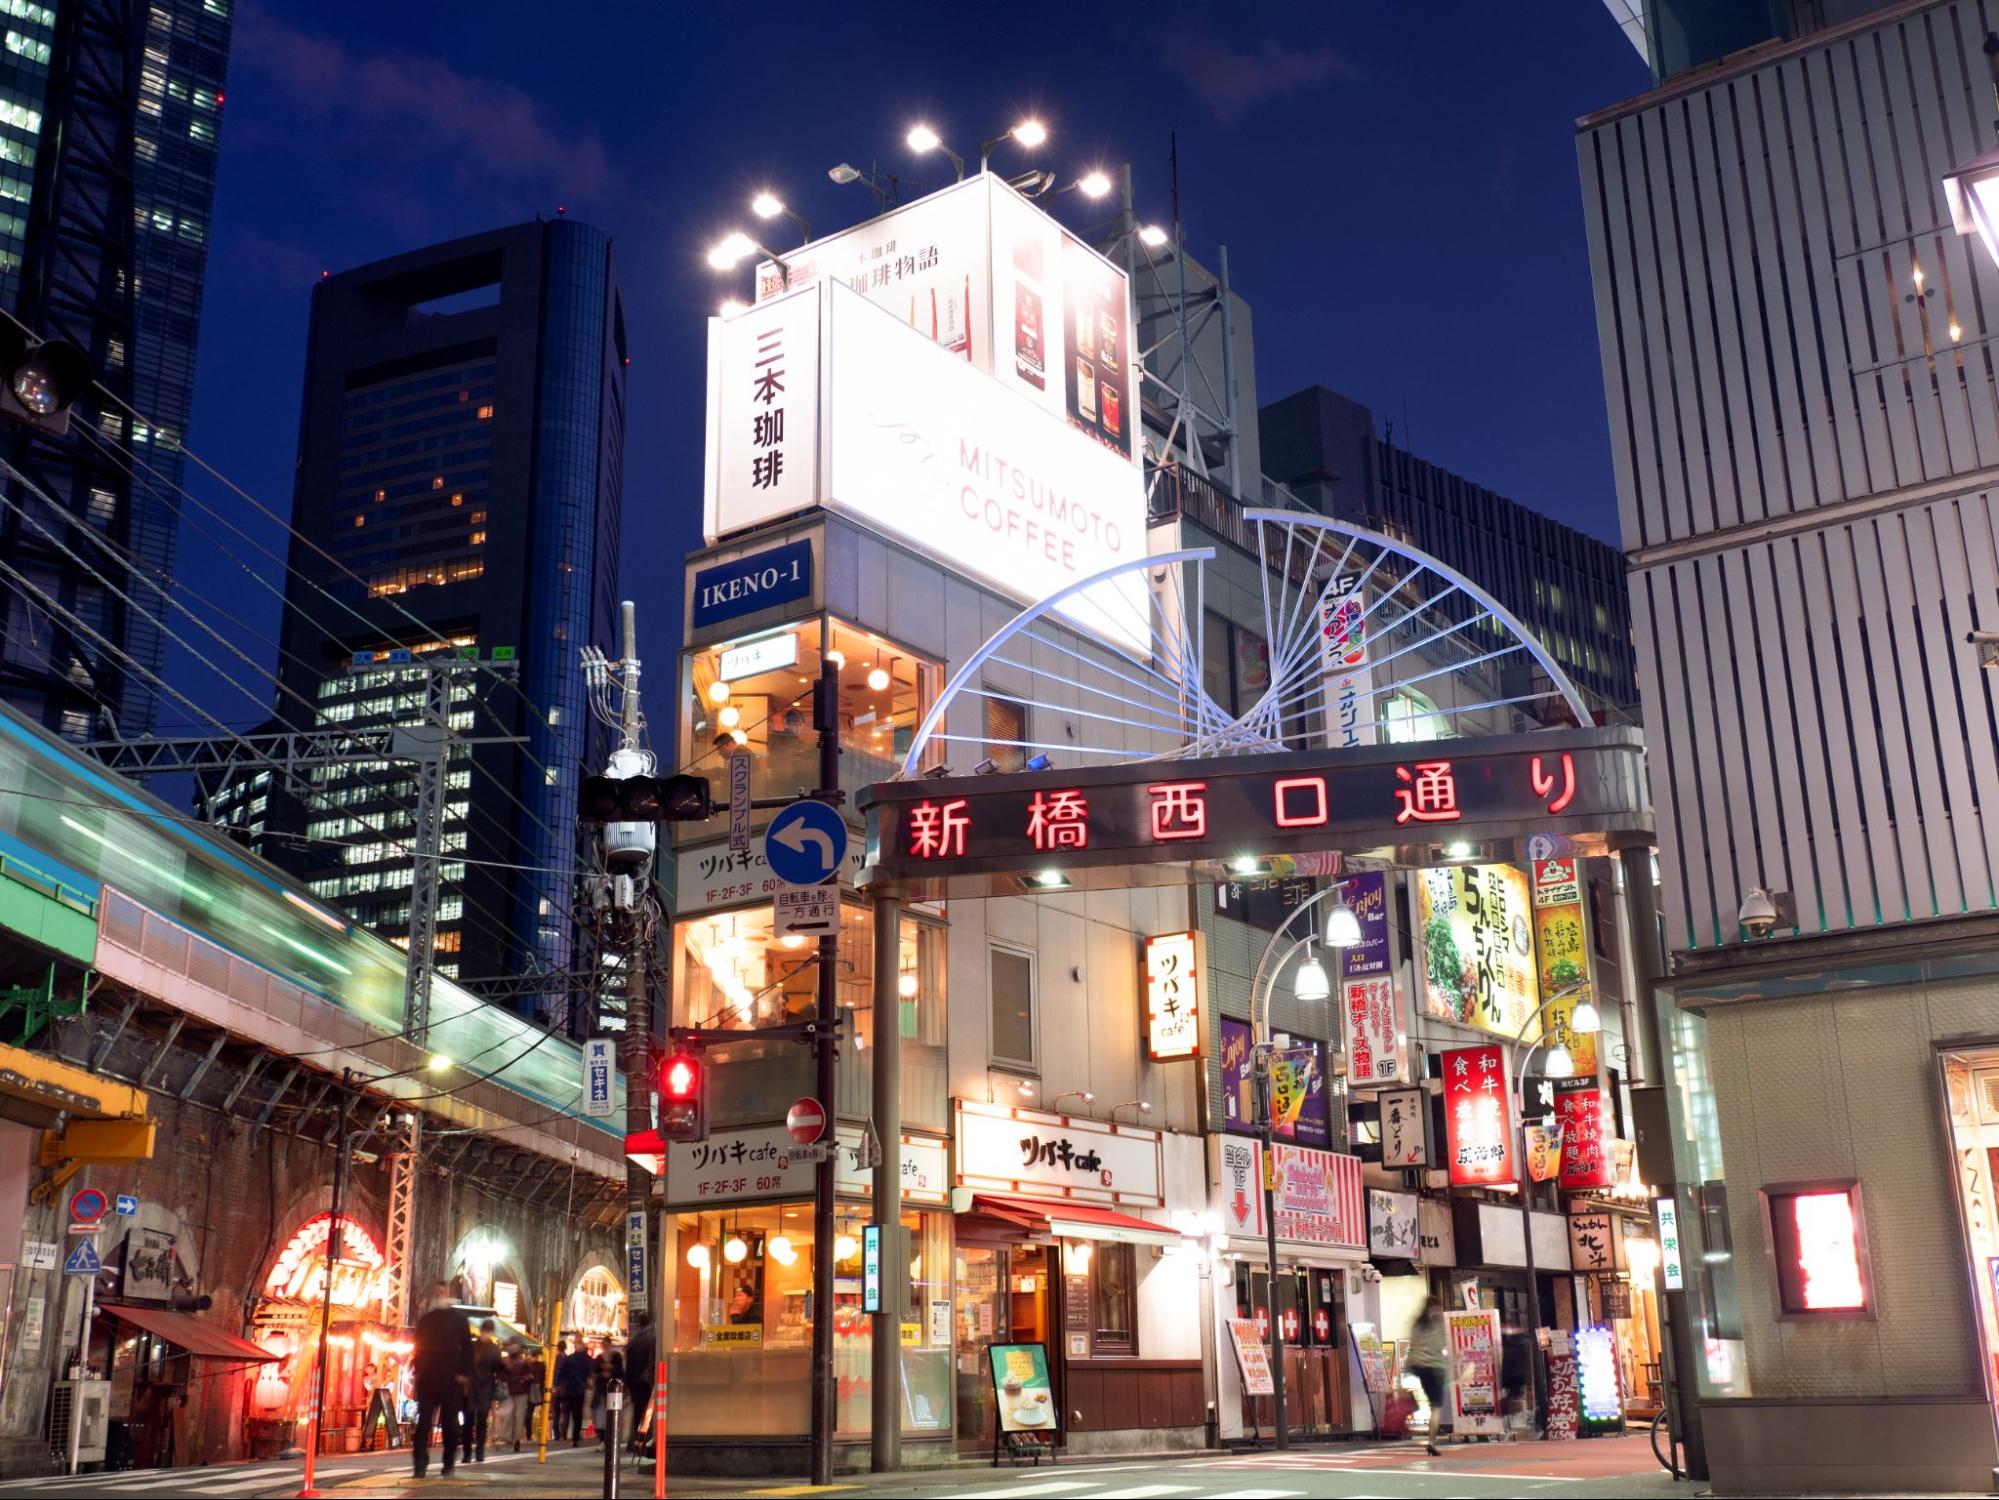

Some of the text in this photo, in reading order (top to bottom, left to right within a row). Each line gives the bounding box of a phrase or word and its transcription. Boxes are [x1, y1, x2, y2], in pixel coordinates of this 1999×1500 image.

[752, 327, 785, 490] 三本珈琲
[959, 436, 1121, 553] MITSUMOTO
[960, 485, 1075, 572] COFFEE
[702, 559, 801, 608] IKENO-1
[732, 757, 749, 847] スクランブル式
[908, 753, 1576, 859] 新橋西口通り
[700, 850, 767, 880] ツバキca
[778, 903, 834, 919] 一方通行
[779, 889, 834, 905] 自転車を除く
[1367, 912, 1384, 922] Bar
[1538, 895, 1550, 904] 4F
[1161, 954, 1180, 1018] ツバキ
[1348, 985, 1372, 1080] 新橋ナース物語
[594, 1068, 605, 1101] セキネ
[1377, 1060, 1396, 1077] 1F
[1563, 1098, 1579, 1160] 食べ放題
[1581, 1097, 1599, 1159] 和牛焼肉
[1225, 1144, 1252, 1169] 当ビル
[1233, 1167, 1247, 1187] 1F
[756, 1176, 781, 1191] 60席
[1372, 1216, 1417, 1251] 一番どり
[1661, 1211, 1680, 1277] 共栄会
[631, 1250, 643, 1291] セキネ
[867, 1239, 877, 1300] 共栄会
[1602, 1285, 1629, 1296] BAR
